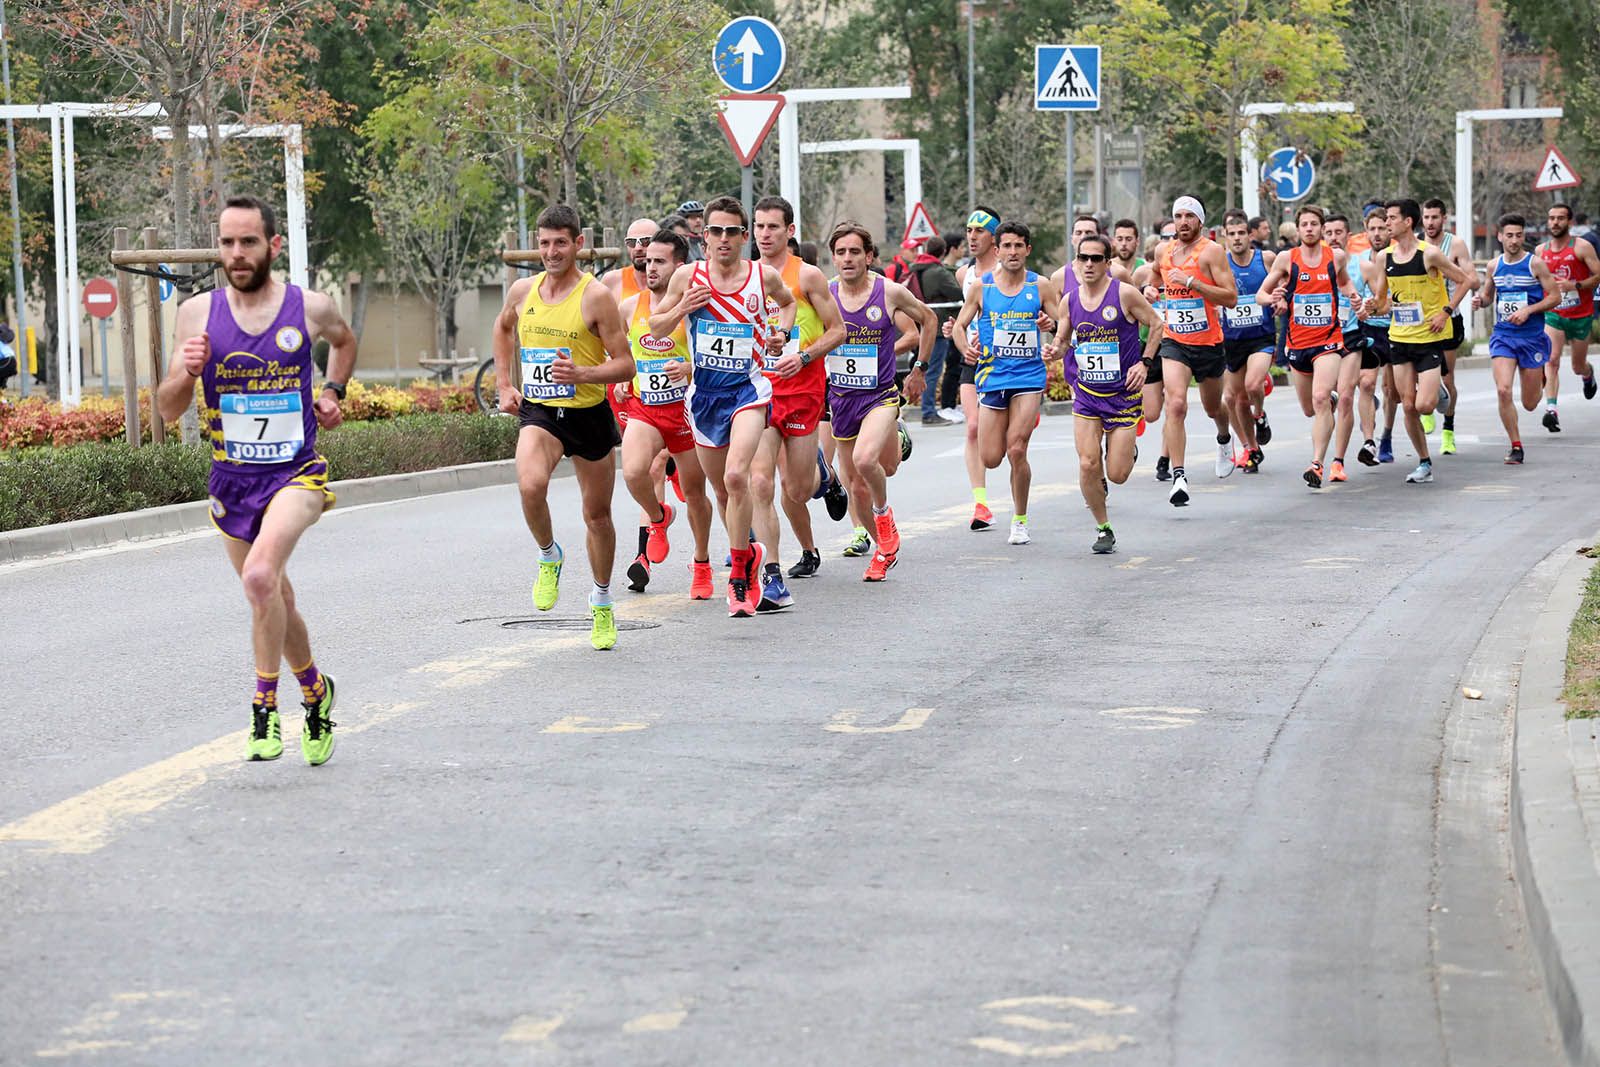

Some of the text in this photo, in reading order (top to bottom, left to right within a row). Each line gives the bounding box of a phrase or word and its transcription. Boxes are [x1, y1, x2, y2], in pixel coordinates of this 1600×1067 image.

[1236, 305, 1252, 317] 59
[1304, 304, 1322, 316] 85
[1503, 302, 1518, 313] 86
[1176, 310, 1194, 323] 35
[568, 331, 578, 339] 42
[1172, 323, 1203, 333] Joma
[710, 337, 735, 356] 41
[1007, 332, 1027, 347] 74
[996, 346, 1033, 357] Joma
[699, 353, 745, 370] Joma
[846, 359, 857, 374] 8
[1087, 356, 1104, 370] 51
[215, 360, 301, 379] Persianas Ruano
[532, 365, 553, 384] 46
[1082, 371, 1115, 381] Joma
[247, 378, 302, 392] Macotera
[649, 373, 672, 391] 82
[833, 374, 872, 386] Joma
[526, 384, 569, 398] Joma
[643, 387, 684, 404] Joma
[253, 417, 270, 441] 7
[232, 443, 293, 459] Joma
